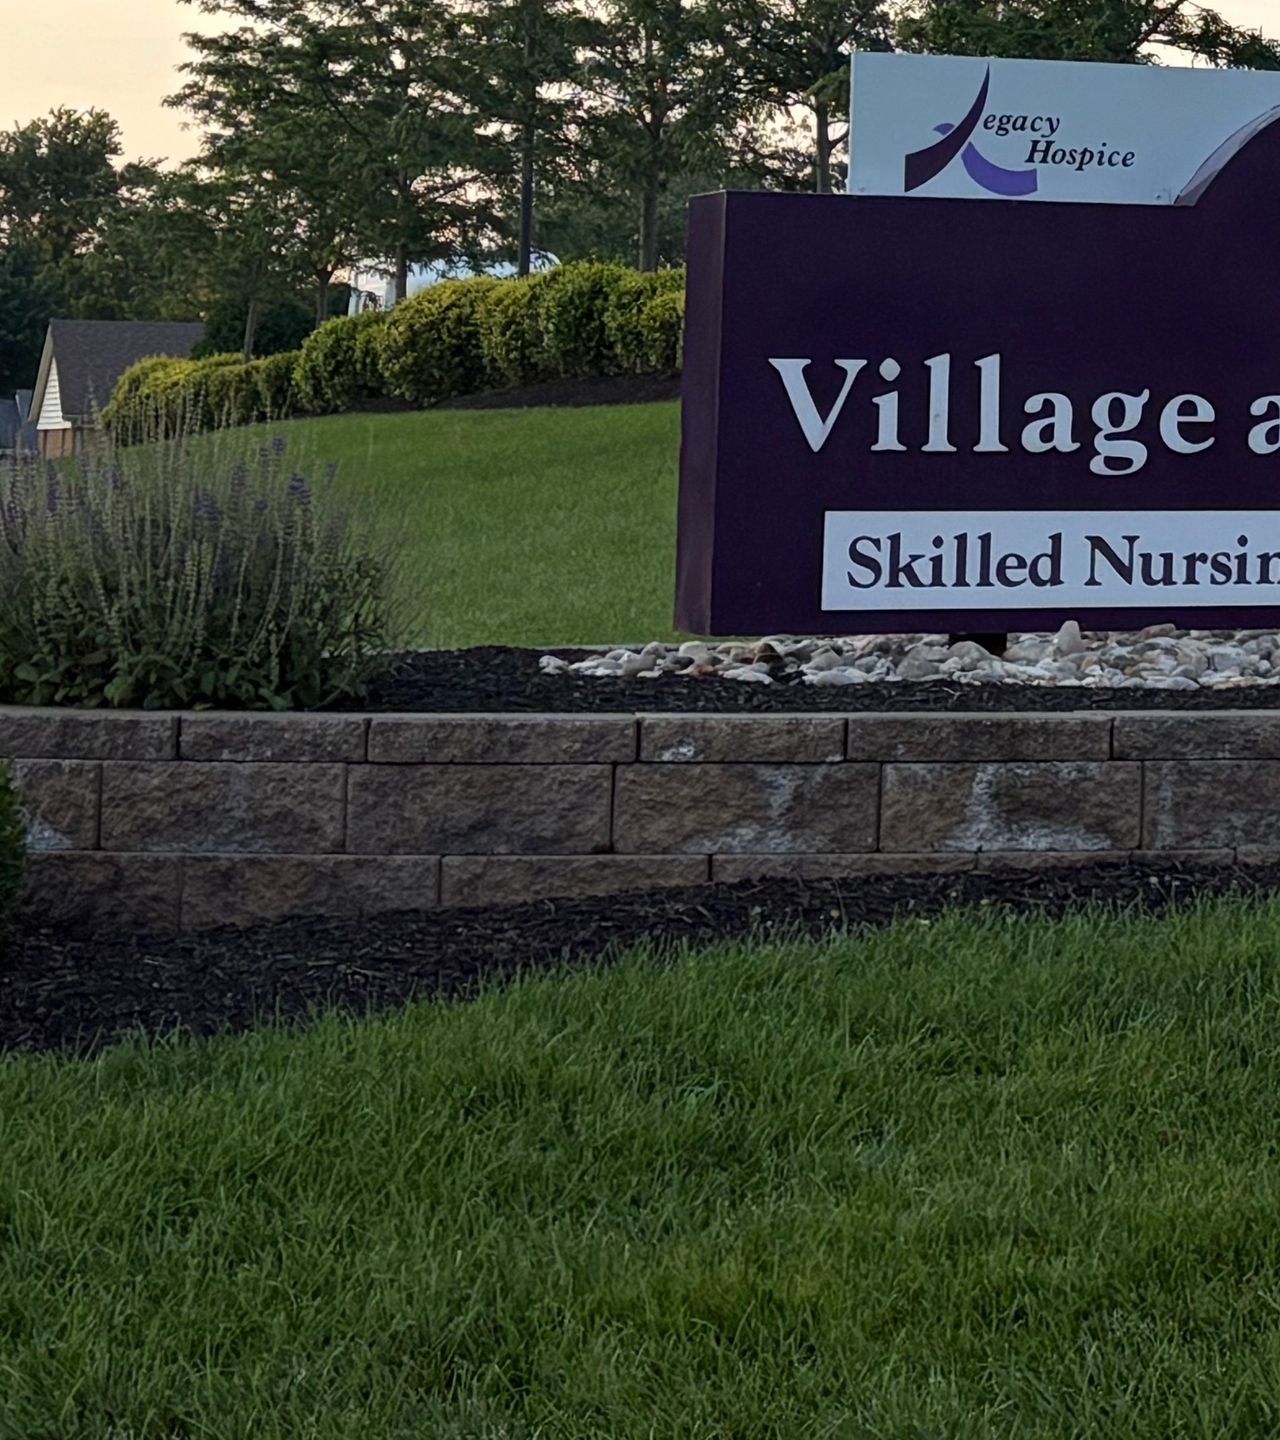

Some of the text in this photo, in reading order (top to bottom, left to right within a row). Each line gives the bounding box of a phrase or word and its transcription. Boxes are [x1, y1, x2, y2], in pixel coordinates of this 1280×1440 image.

[1024, 139, 1136, 171] Hospice
[768, 352, 1216, 476] Village
[847, 531, 1065, 589] Skilled
